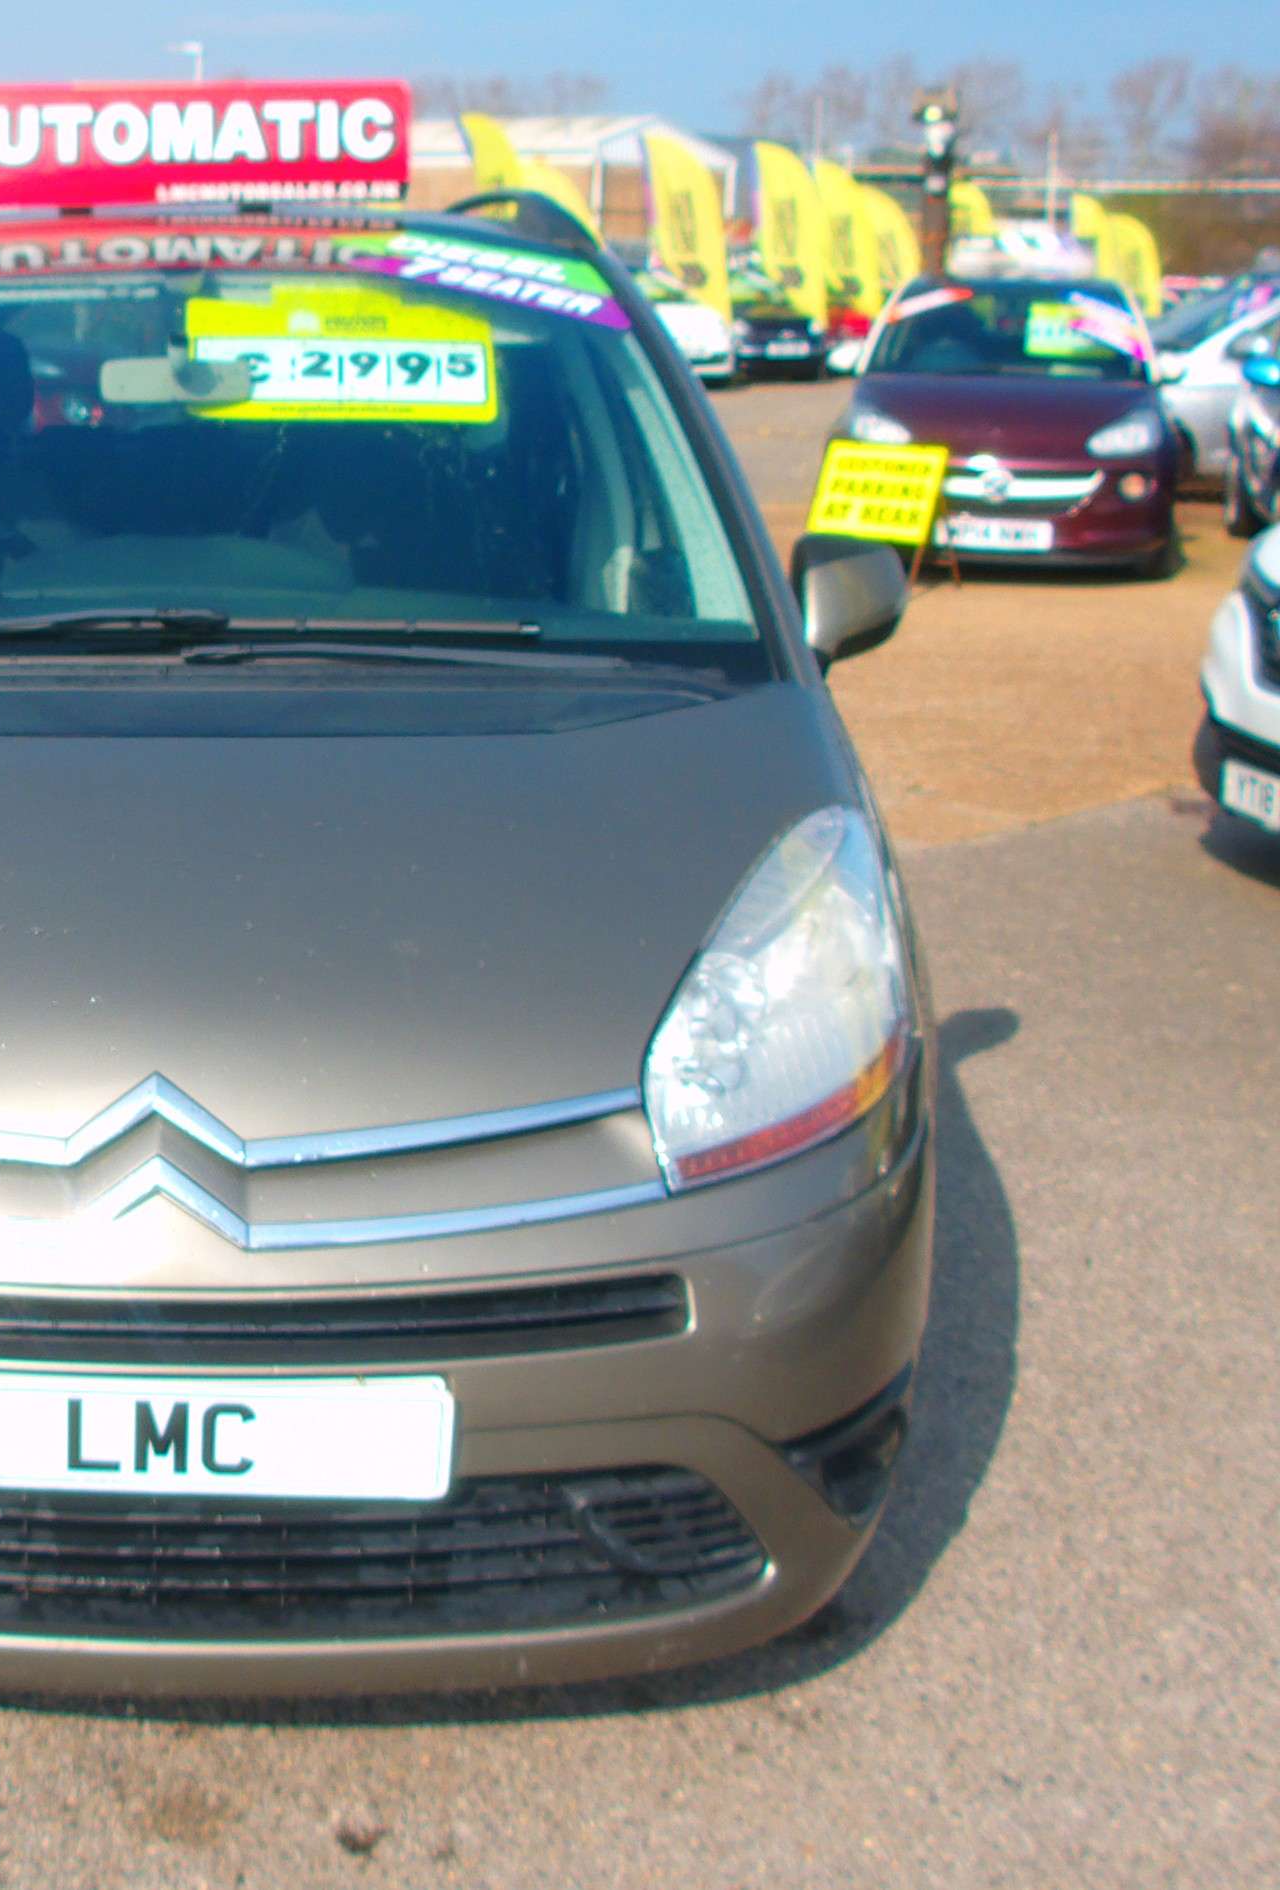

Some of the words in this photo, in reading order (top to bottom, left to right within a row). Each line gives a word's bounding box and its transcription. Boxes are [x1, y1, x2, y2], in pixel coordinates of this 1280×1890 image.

[400, 255, 448, 279] 7
[438, 264, 604, 317] SEATER
[831, 478, 923, 500] PARKING
[823, 502, 853, 520] AT
[861, 504, 920, 526] REAR
[66, 1398, 256, 1476] LMC
